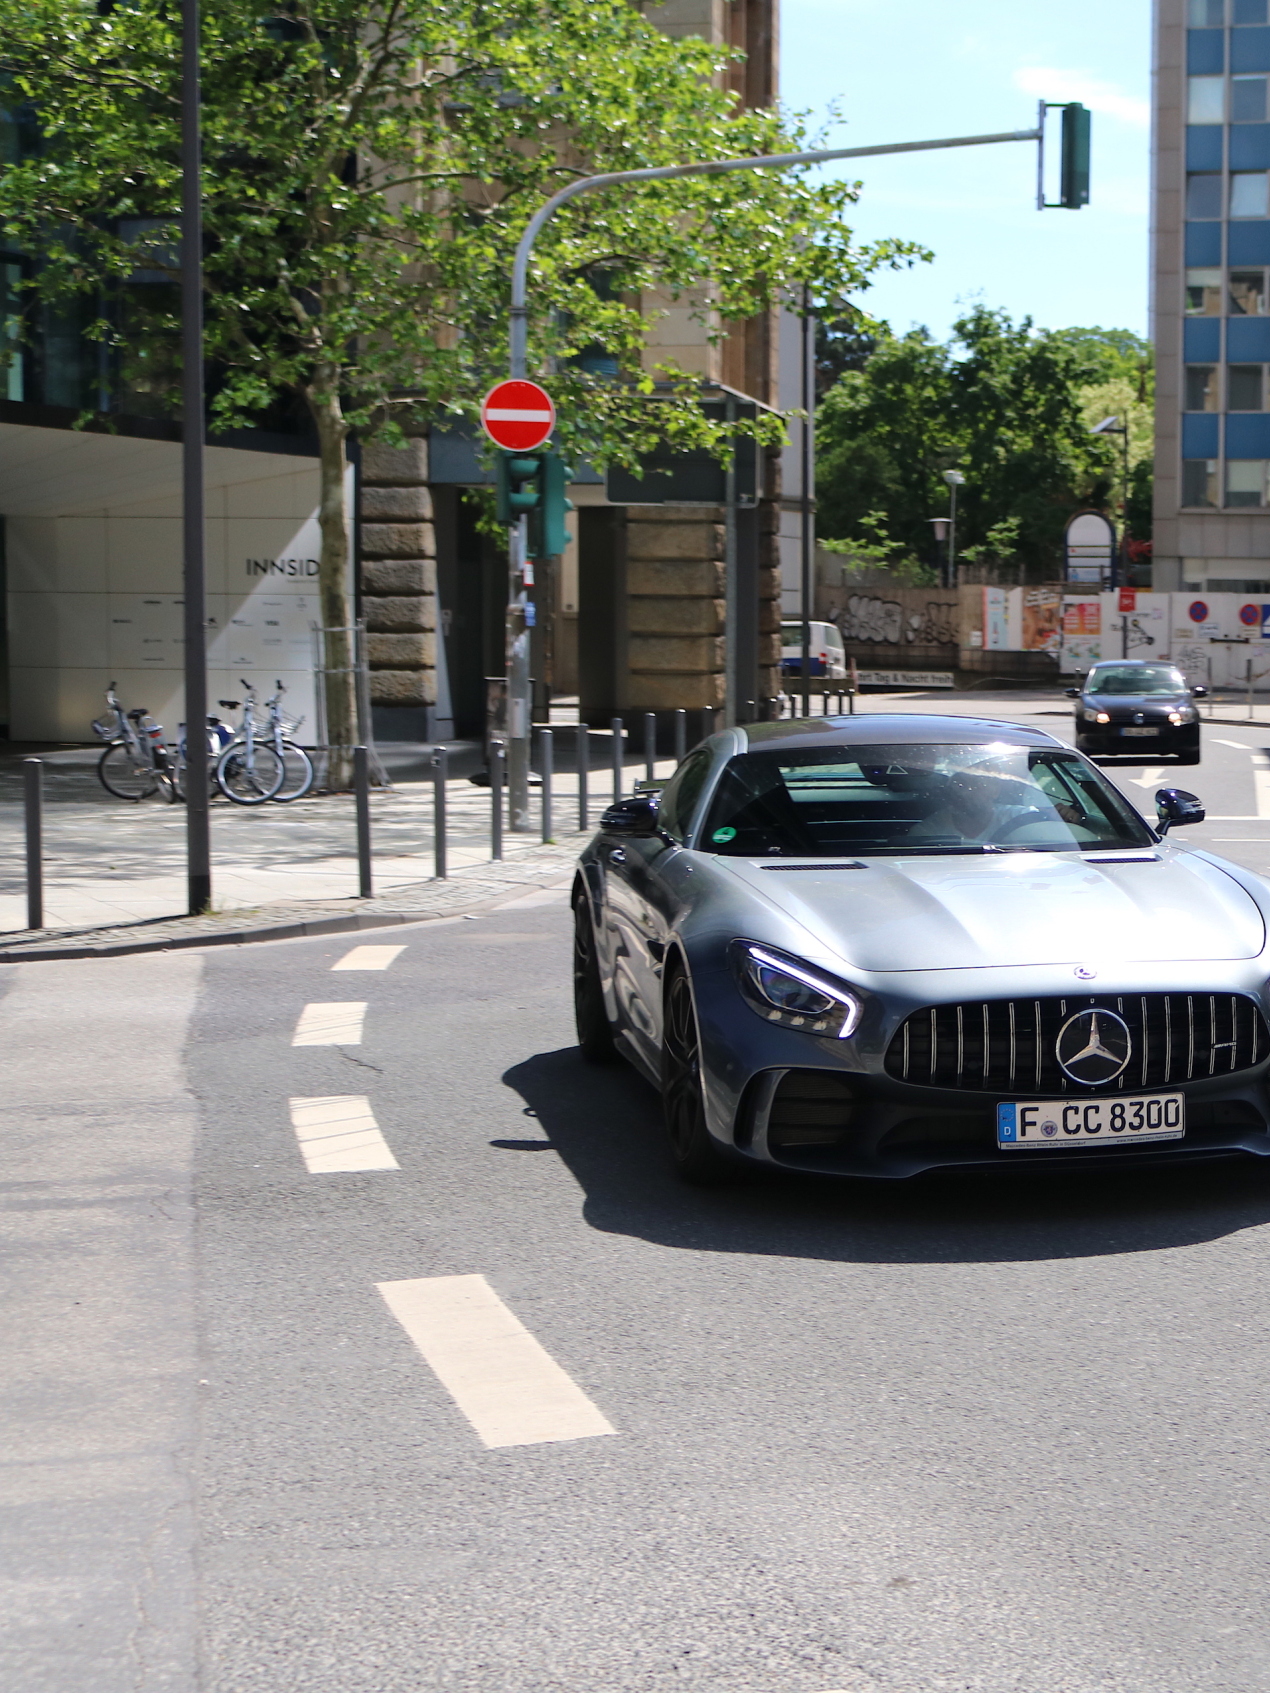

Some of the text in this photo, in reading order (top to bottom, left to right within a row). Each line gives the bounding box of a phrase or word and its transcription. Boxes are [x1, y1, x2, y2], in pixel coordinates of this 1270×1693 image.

[1020, 1099, 1180, 1136] F CC 8300
[1003, 1126, 1011, 1136] D
